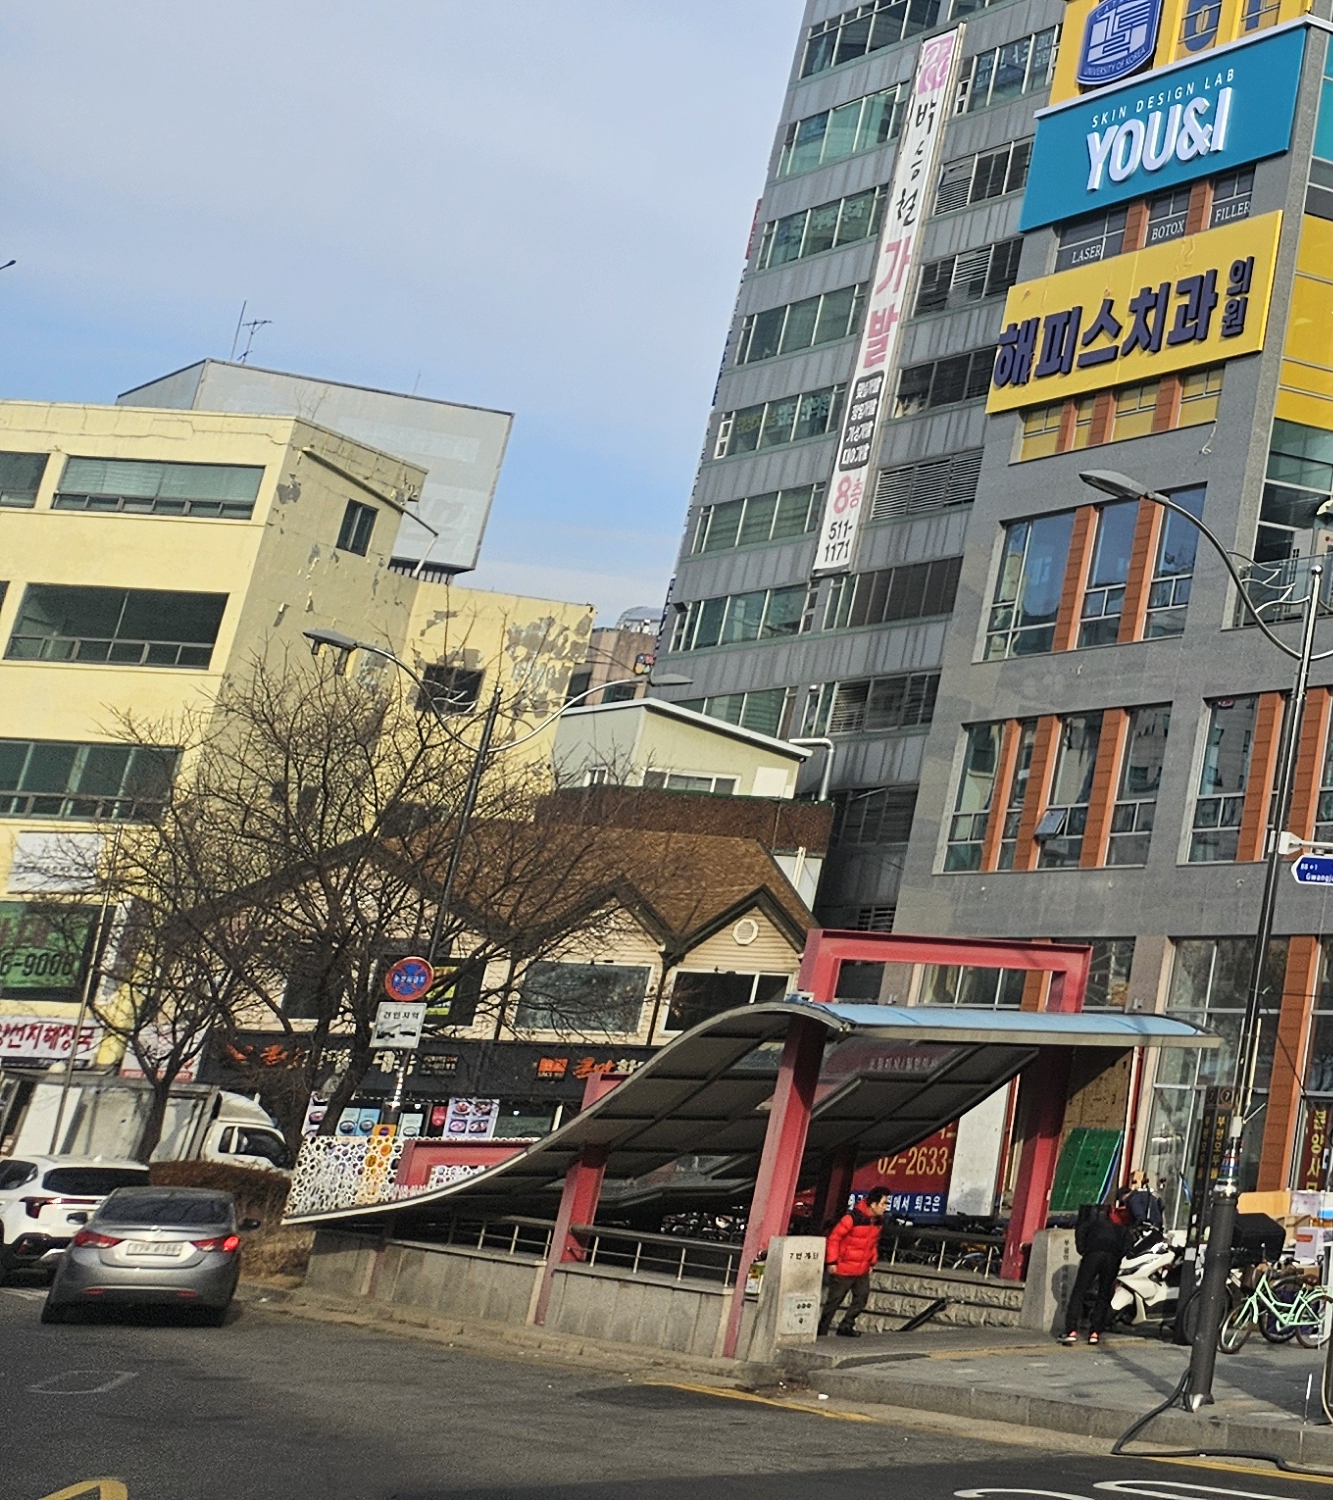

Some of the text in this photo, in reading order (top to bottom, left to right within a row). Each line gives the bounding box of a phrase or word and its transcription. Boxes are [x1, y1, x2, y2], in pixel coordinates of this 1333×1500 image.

[1091, 67, 1236, 129] SKIN DESIGN LAB
[1086, 87, 1235, 190] YOU&I
[1071, 201, 1251, 264] LASER BOTOX FILLER
[863, 235, 911, 370] 가발
[994, 256, 1255, 388] 해피스치과 의원
[833, 476, 863, 514] 8층
[825, 539, 850, 562] 1171
[828, 519, 852, 540] 511-
[383, 1011, 420, 1020] 견인지역
